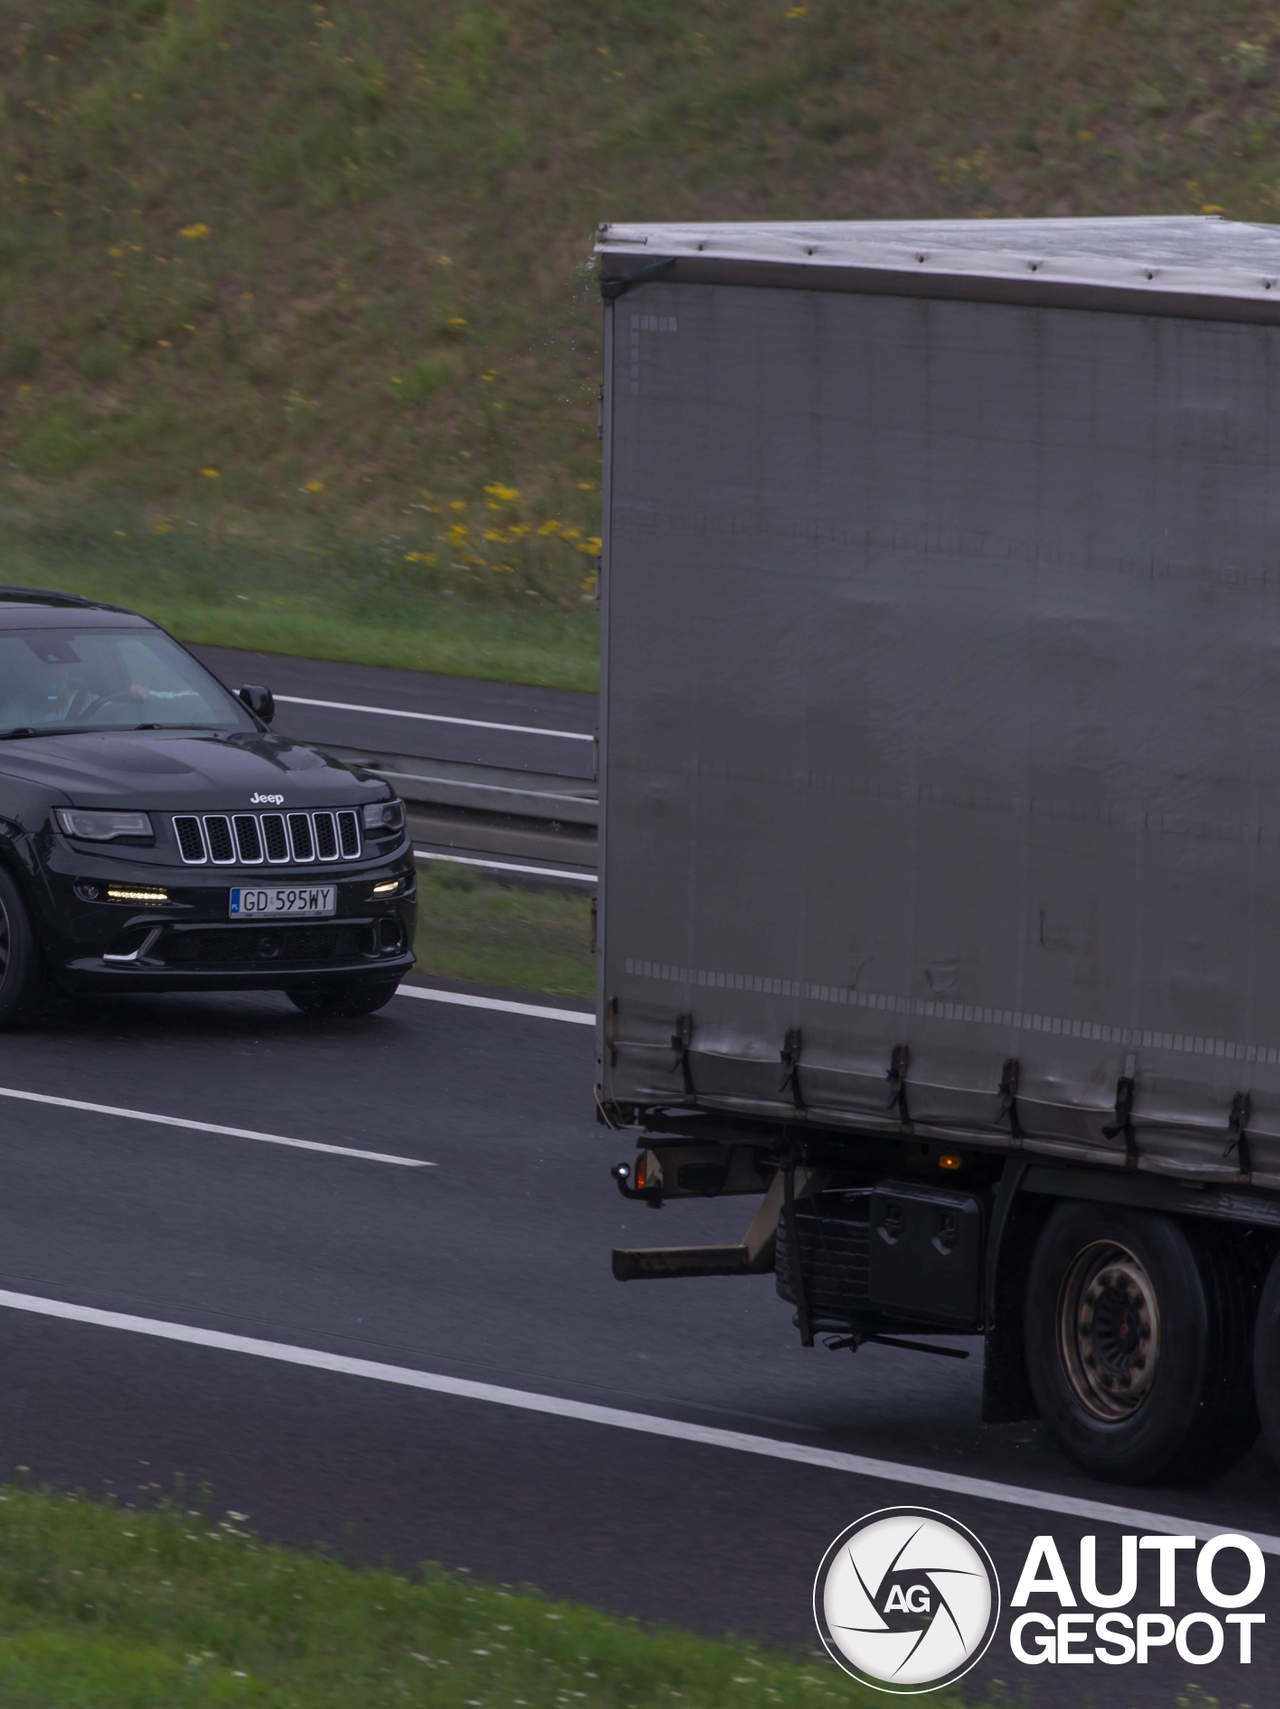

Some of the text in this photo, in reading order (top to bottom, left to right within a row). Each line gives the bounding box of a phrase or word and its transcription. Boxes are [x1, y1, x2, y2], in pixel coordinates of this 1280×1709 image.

[250, 792, 284, 805] Jeep
[244, 889, 330, 911] GD 595WY
